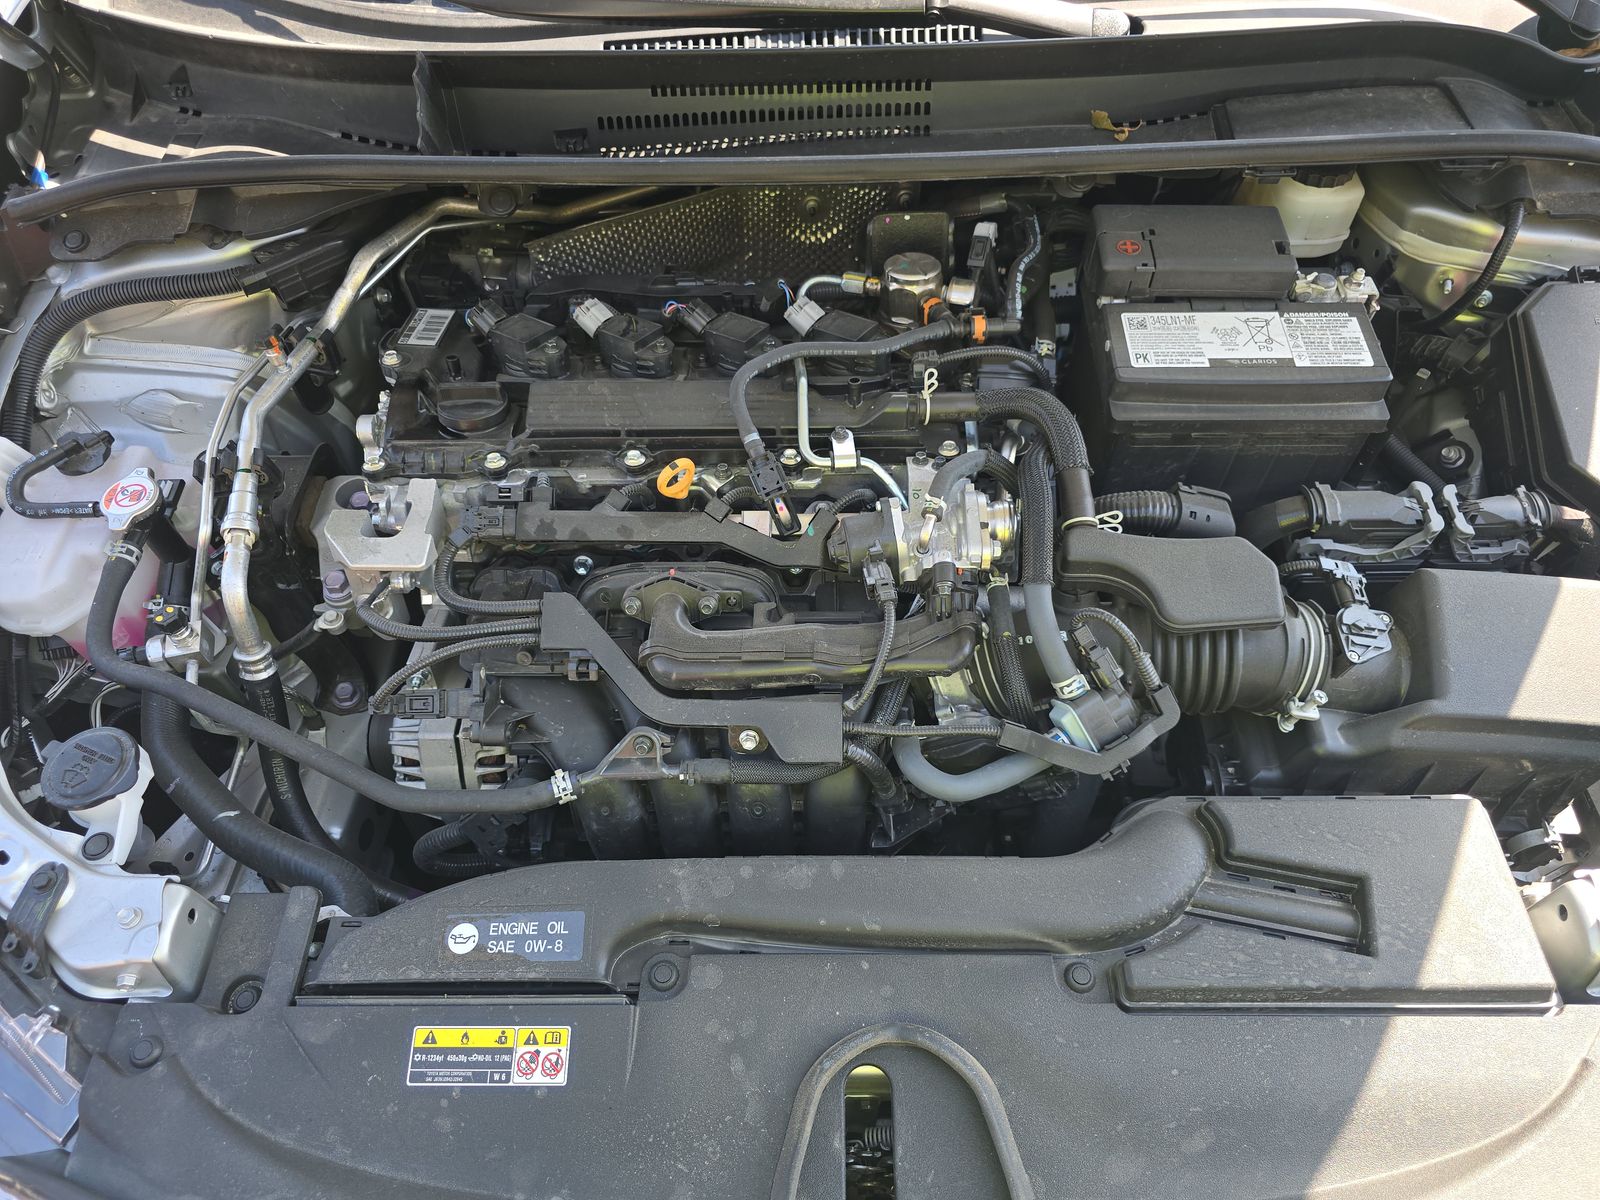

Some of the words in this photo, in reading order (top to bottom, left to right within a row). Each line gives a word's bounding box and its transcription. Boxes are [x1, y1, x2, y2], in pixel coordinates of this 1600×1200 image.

[1151, 316, 1197, 326] 345LN1-MF
[1258, 345, 1273, 353] Pb
[1135, 353, 1150, 364] PK
[489, 921, 538, 936] ENGINE
[547, 921, 569, 935] OIL
[487, 940, 515, 954] SAE
[525, 939, 564, 953] 0W-8
[494, 1053, 500, 1062] 12
[494, 1073, 500, 1081] W
[502, 1073, 506, 1081] 6
